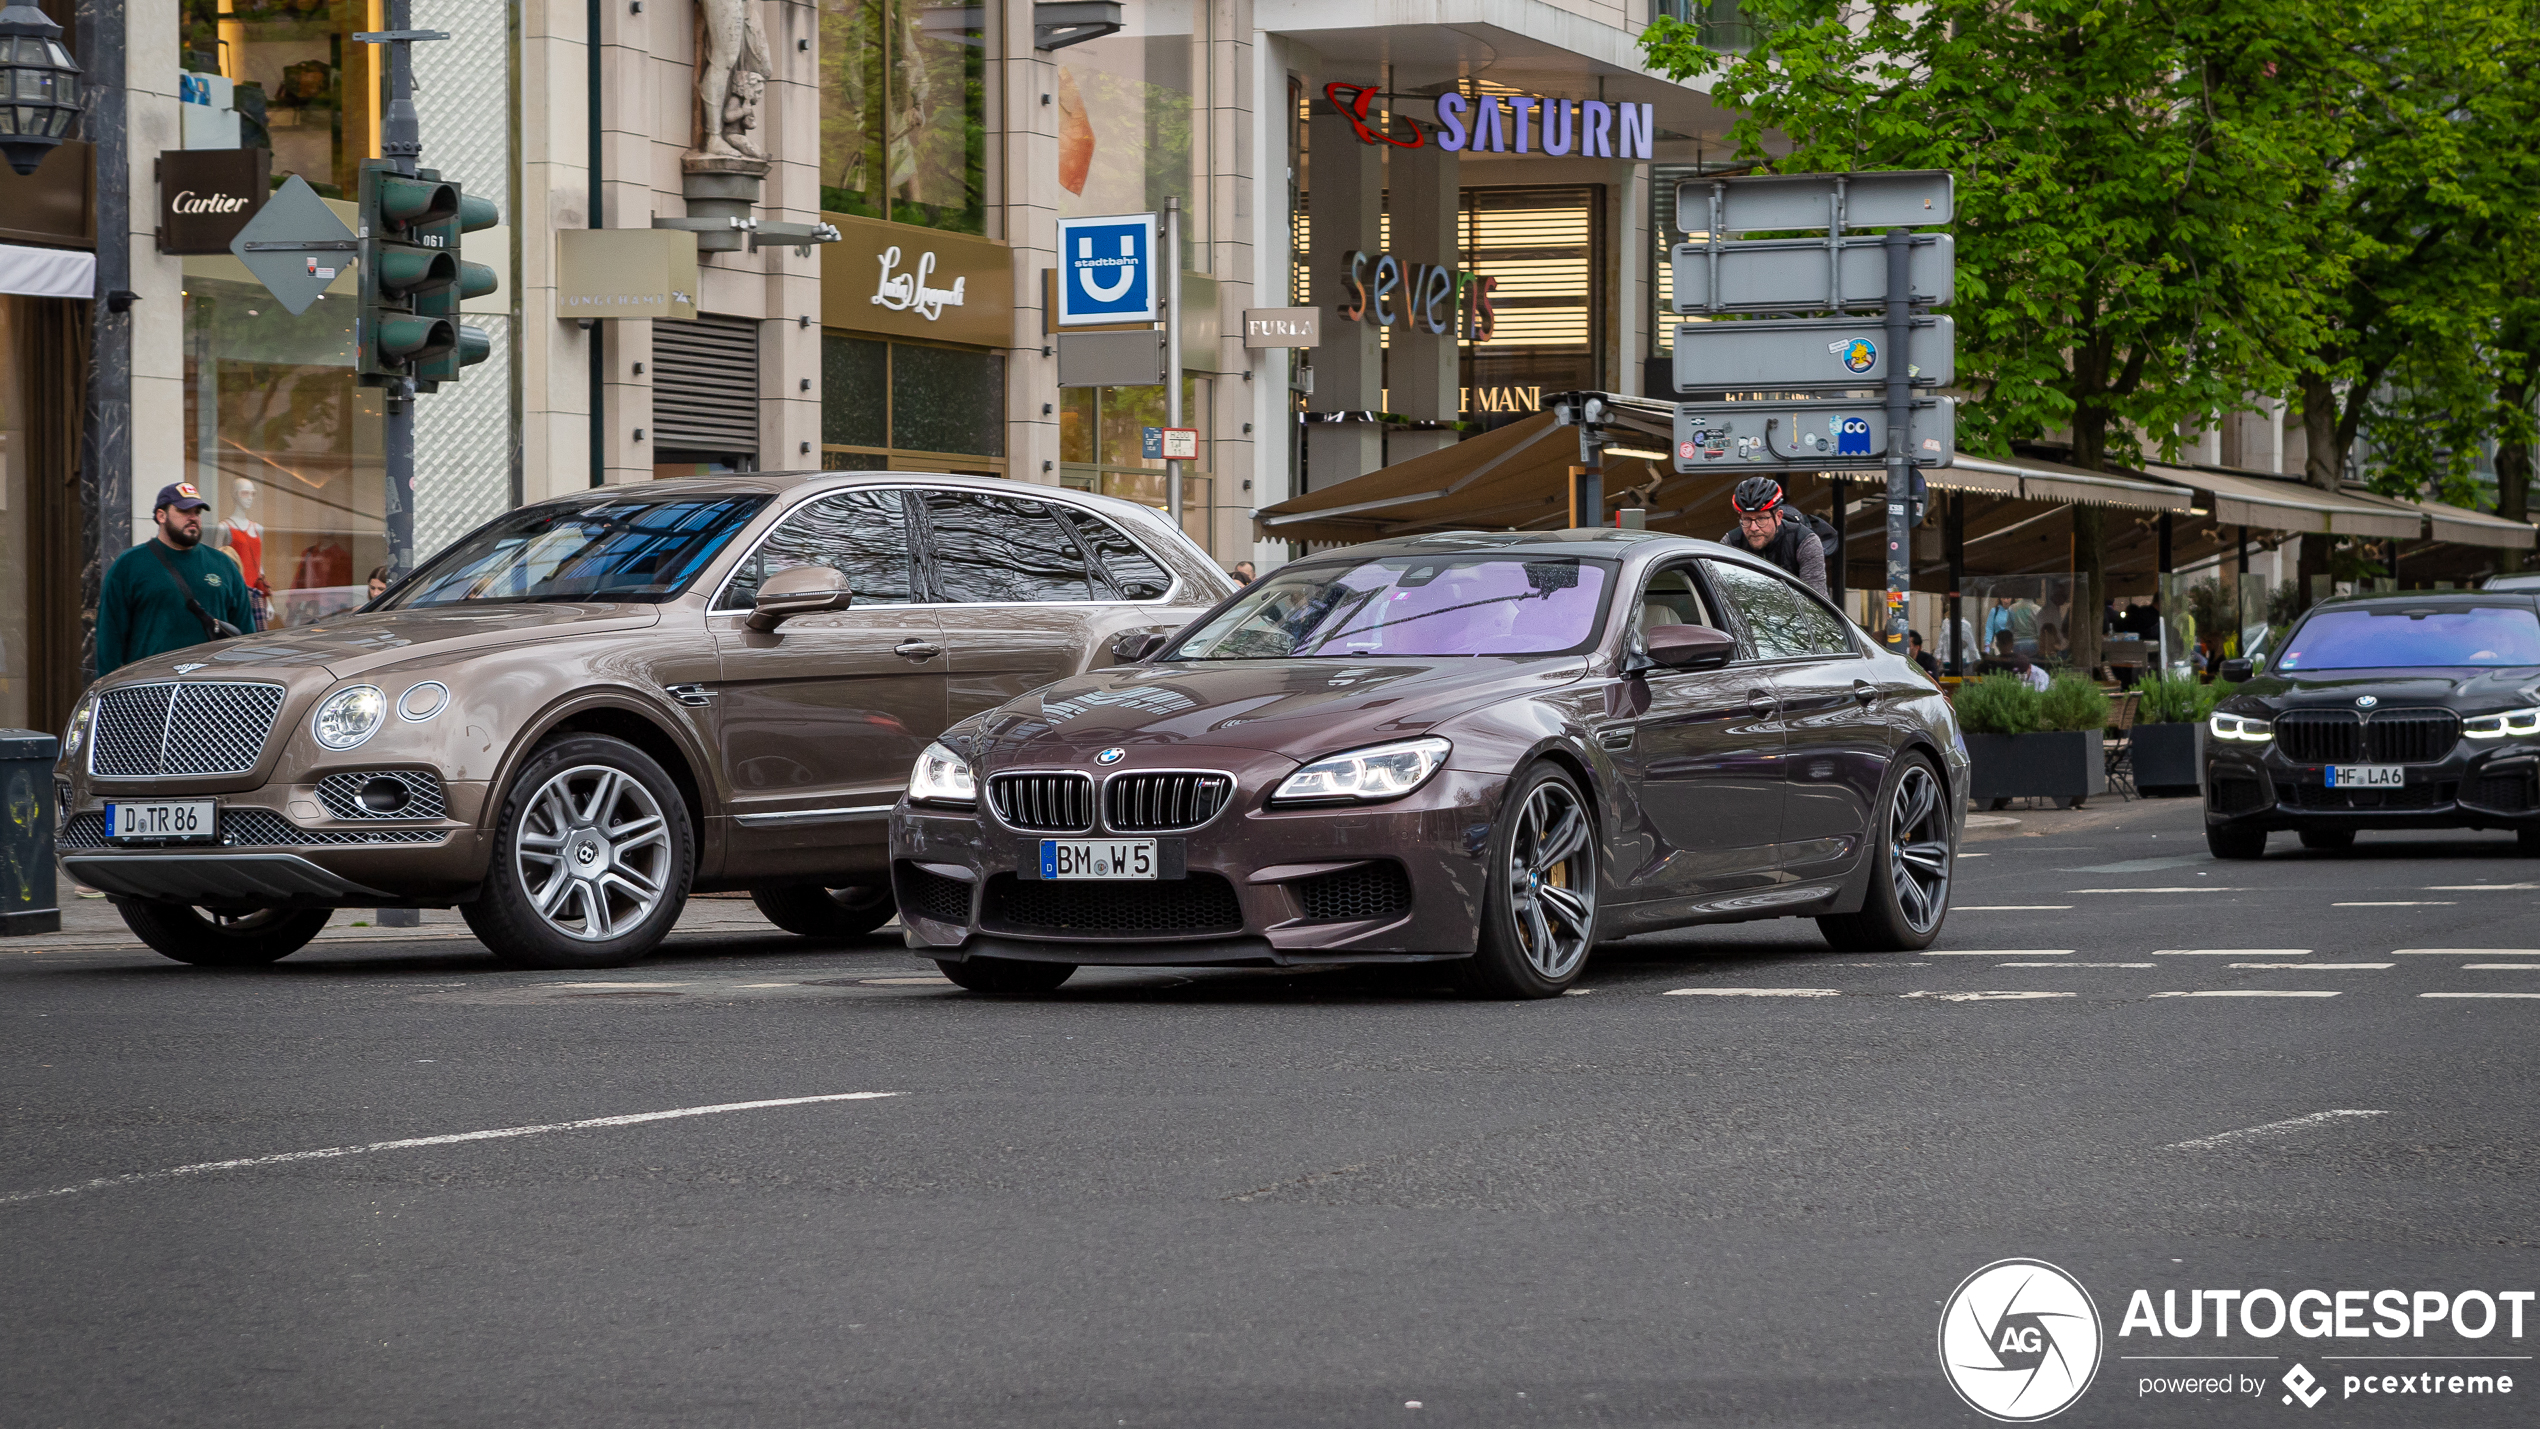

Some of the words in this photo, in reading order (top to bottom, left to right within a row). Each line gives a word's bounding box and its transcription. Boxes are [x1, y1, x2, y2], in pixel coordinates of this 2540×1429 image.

[1436, 92, 1653, 159] SATURN
[172, 190, 249, 214] Cartier
[423, 235, 444, 247] 061
[1074, 256, 1139, 268] stadtbahn
[1248, 320, 1314, 336] FURLA
[2335, 768, 2357, 784] HF
[124, 807, 136, 832] D
[147, 807, 170, 832] TR
[174, 806, 198, 831] 86
[1046, 863, 1053, 872] D
[1057, 845, 1092, 875] BM
[1110, 845, 1127, 875] W
[1133, 845, 1150, 874] 5
